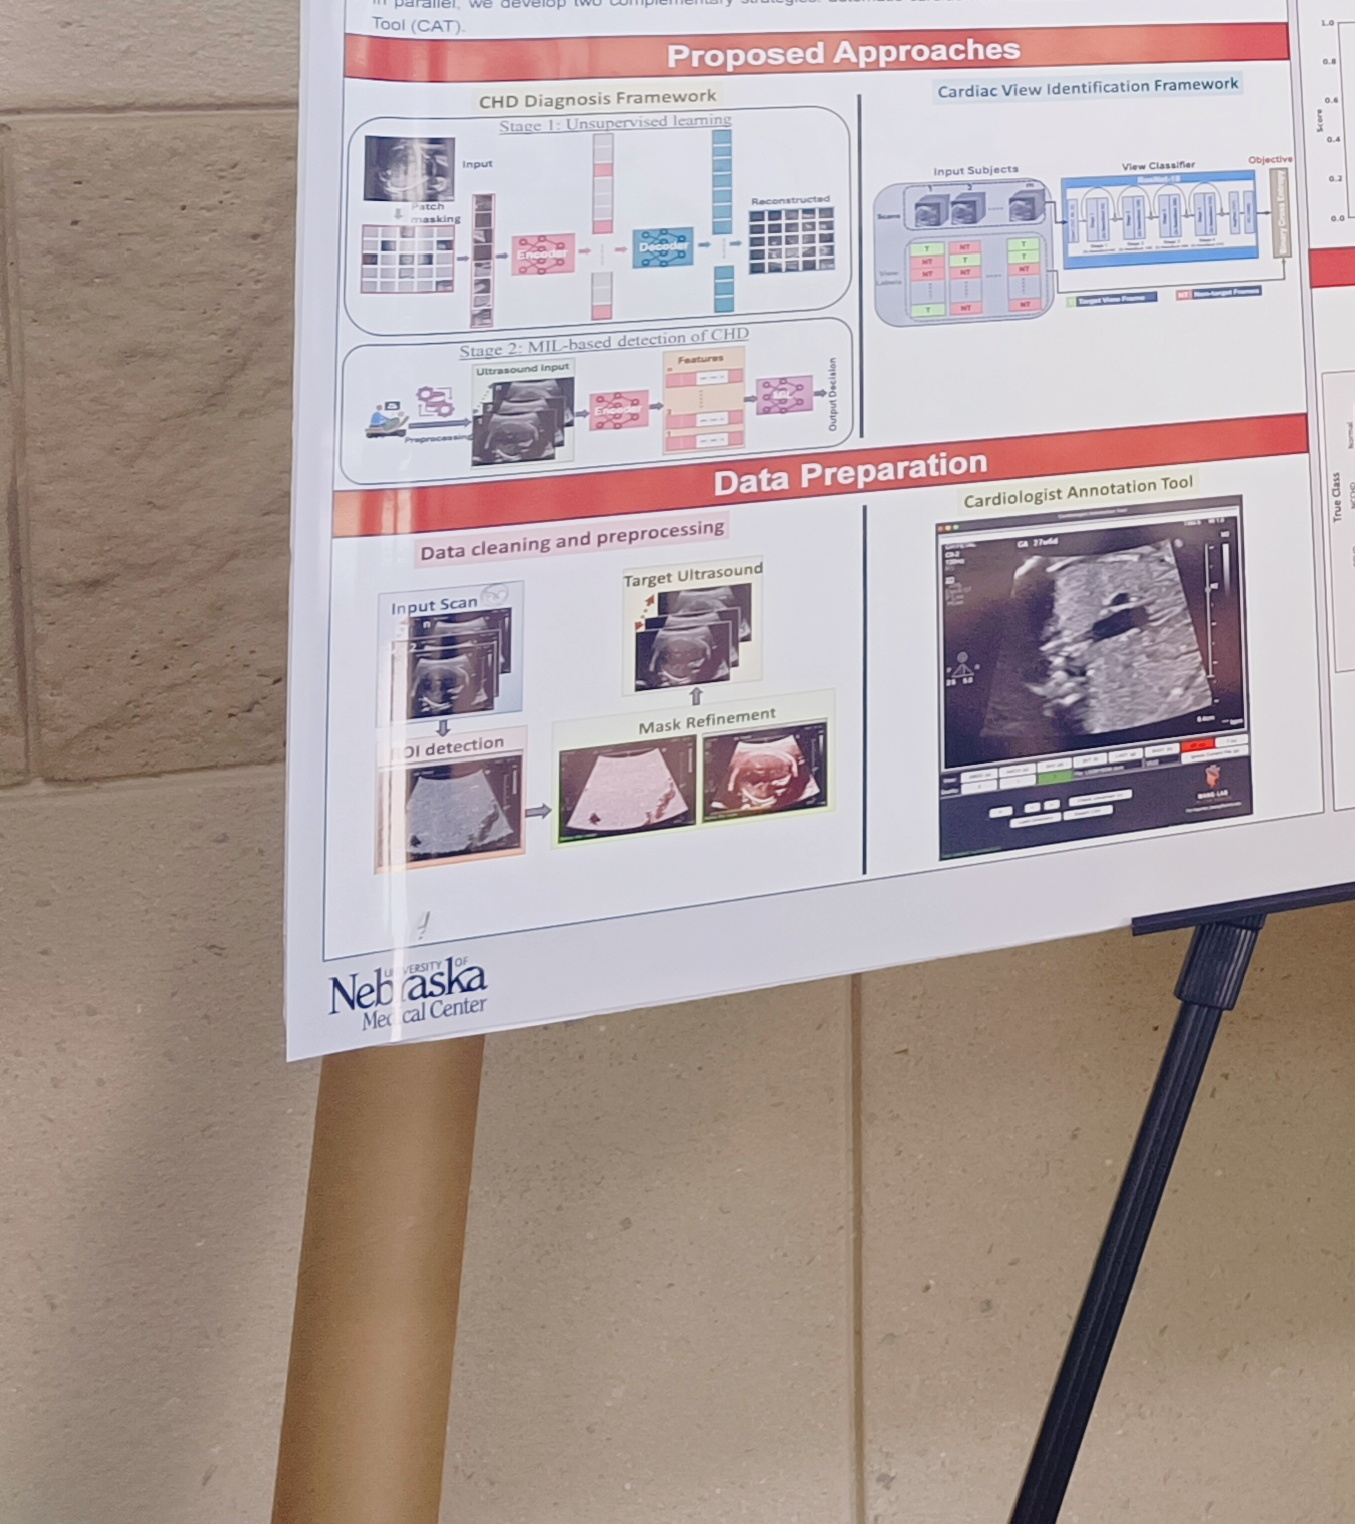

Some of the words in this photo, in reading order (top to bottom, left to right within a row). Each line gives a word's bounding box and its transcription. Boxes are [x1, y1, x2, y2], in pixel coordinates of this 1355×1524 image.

[668, 43, 823, 72] Proposed
[834, 38, 1021, 68] Approaches
[938, 83, 997, 99] Cardiac
[1002, 83, 1041, 97] View
[1047, 79, 1149, 95] Identification
[1154, 76, 1239, 92] Framework
[934, 167, 964, 177] Input
[968, 165, 1018, 176] Subjects
[1122, 163, 1147, 171] View
[1150, 160, 1195, 170] Classifier
[1248, 155, 1293, 165] Objective
[460, 342, 511, 359] Stage
[515, 341, 525, 356] 2:
[529, 335, 612, 354] MIL-based
[617, 332, 686, 350] detection
[690, 329, 707, 344] of
[711, 327, 750, 342] CHD
[714, 467, 790, 496] Data
[801, 450, 988, 488] Preparation
[964, 487, 1062, 510] Cardiologist
[1067, 480, 1156, 500] Annotation
[1160, 475, 1194, 491] Tool
[421, 543, 466, 561] Data
[471, 535, 551, 558] cleaning
[556, 531, 590, 549] and
[597, 520, 725, 547] preprocessing
[392, 598, 435, 615] Input
[440, 595, 478, 611] Scan
[639, 718, 682, 734] Mask
[686, 707, 776, 729] Refinement
[430, 735, 504, 757] detection
[362, 1005, 426, 1030] Mecal
[430, 996, 487, 1017] Center
